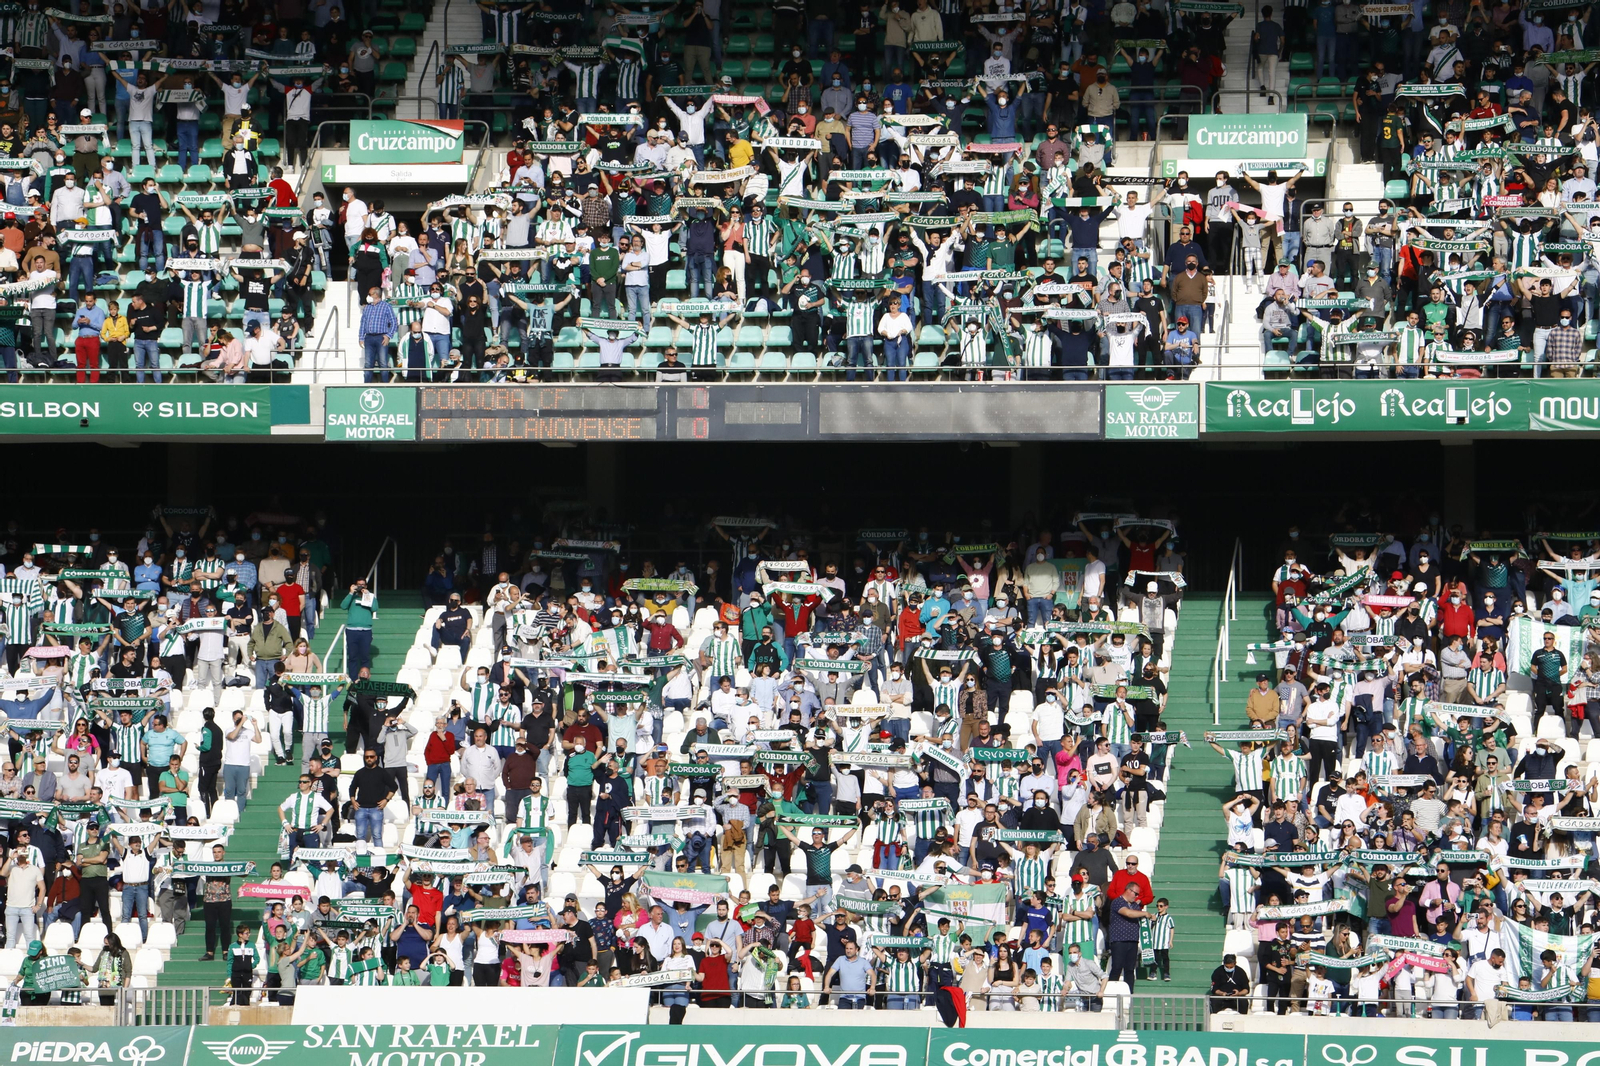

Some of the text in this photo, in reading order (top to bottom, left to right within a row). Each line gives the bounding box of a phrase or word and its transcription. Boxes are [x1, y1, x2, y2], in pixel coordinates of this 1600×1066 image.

[358, 132, 456, 153] Cruzcampo
[1197, 128, 1299, 147] Cruzcampo
[325, 168, 333, 179] 4
[1166, 163, 1174, 174] 5
[540, 388, 568, 410] CF
[1144, 395, 1162, 403] MINI
[0, 402, 100, 418] SILBON
[158, 402, 258, 418] SILBON
[328, 414, 413, 426] SAN RAFAEL
[1106, 412, 1196, 424] SAN RAFAEL
[346, 428, 395, 439] MOTOR
[422, 418, 450, 440] CF
[466, 418, 642, 440] VILLANOVENSE
[1124, 426, 1178, 438] MOTOR
[634, 854, 646, 862] CF
[303, 1024, 540, 1048] SAN RAFAEL
[232, 1046, 262, 1055] MINI
[944, 1042, 1099, 1066] Comercial
